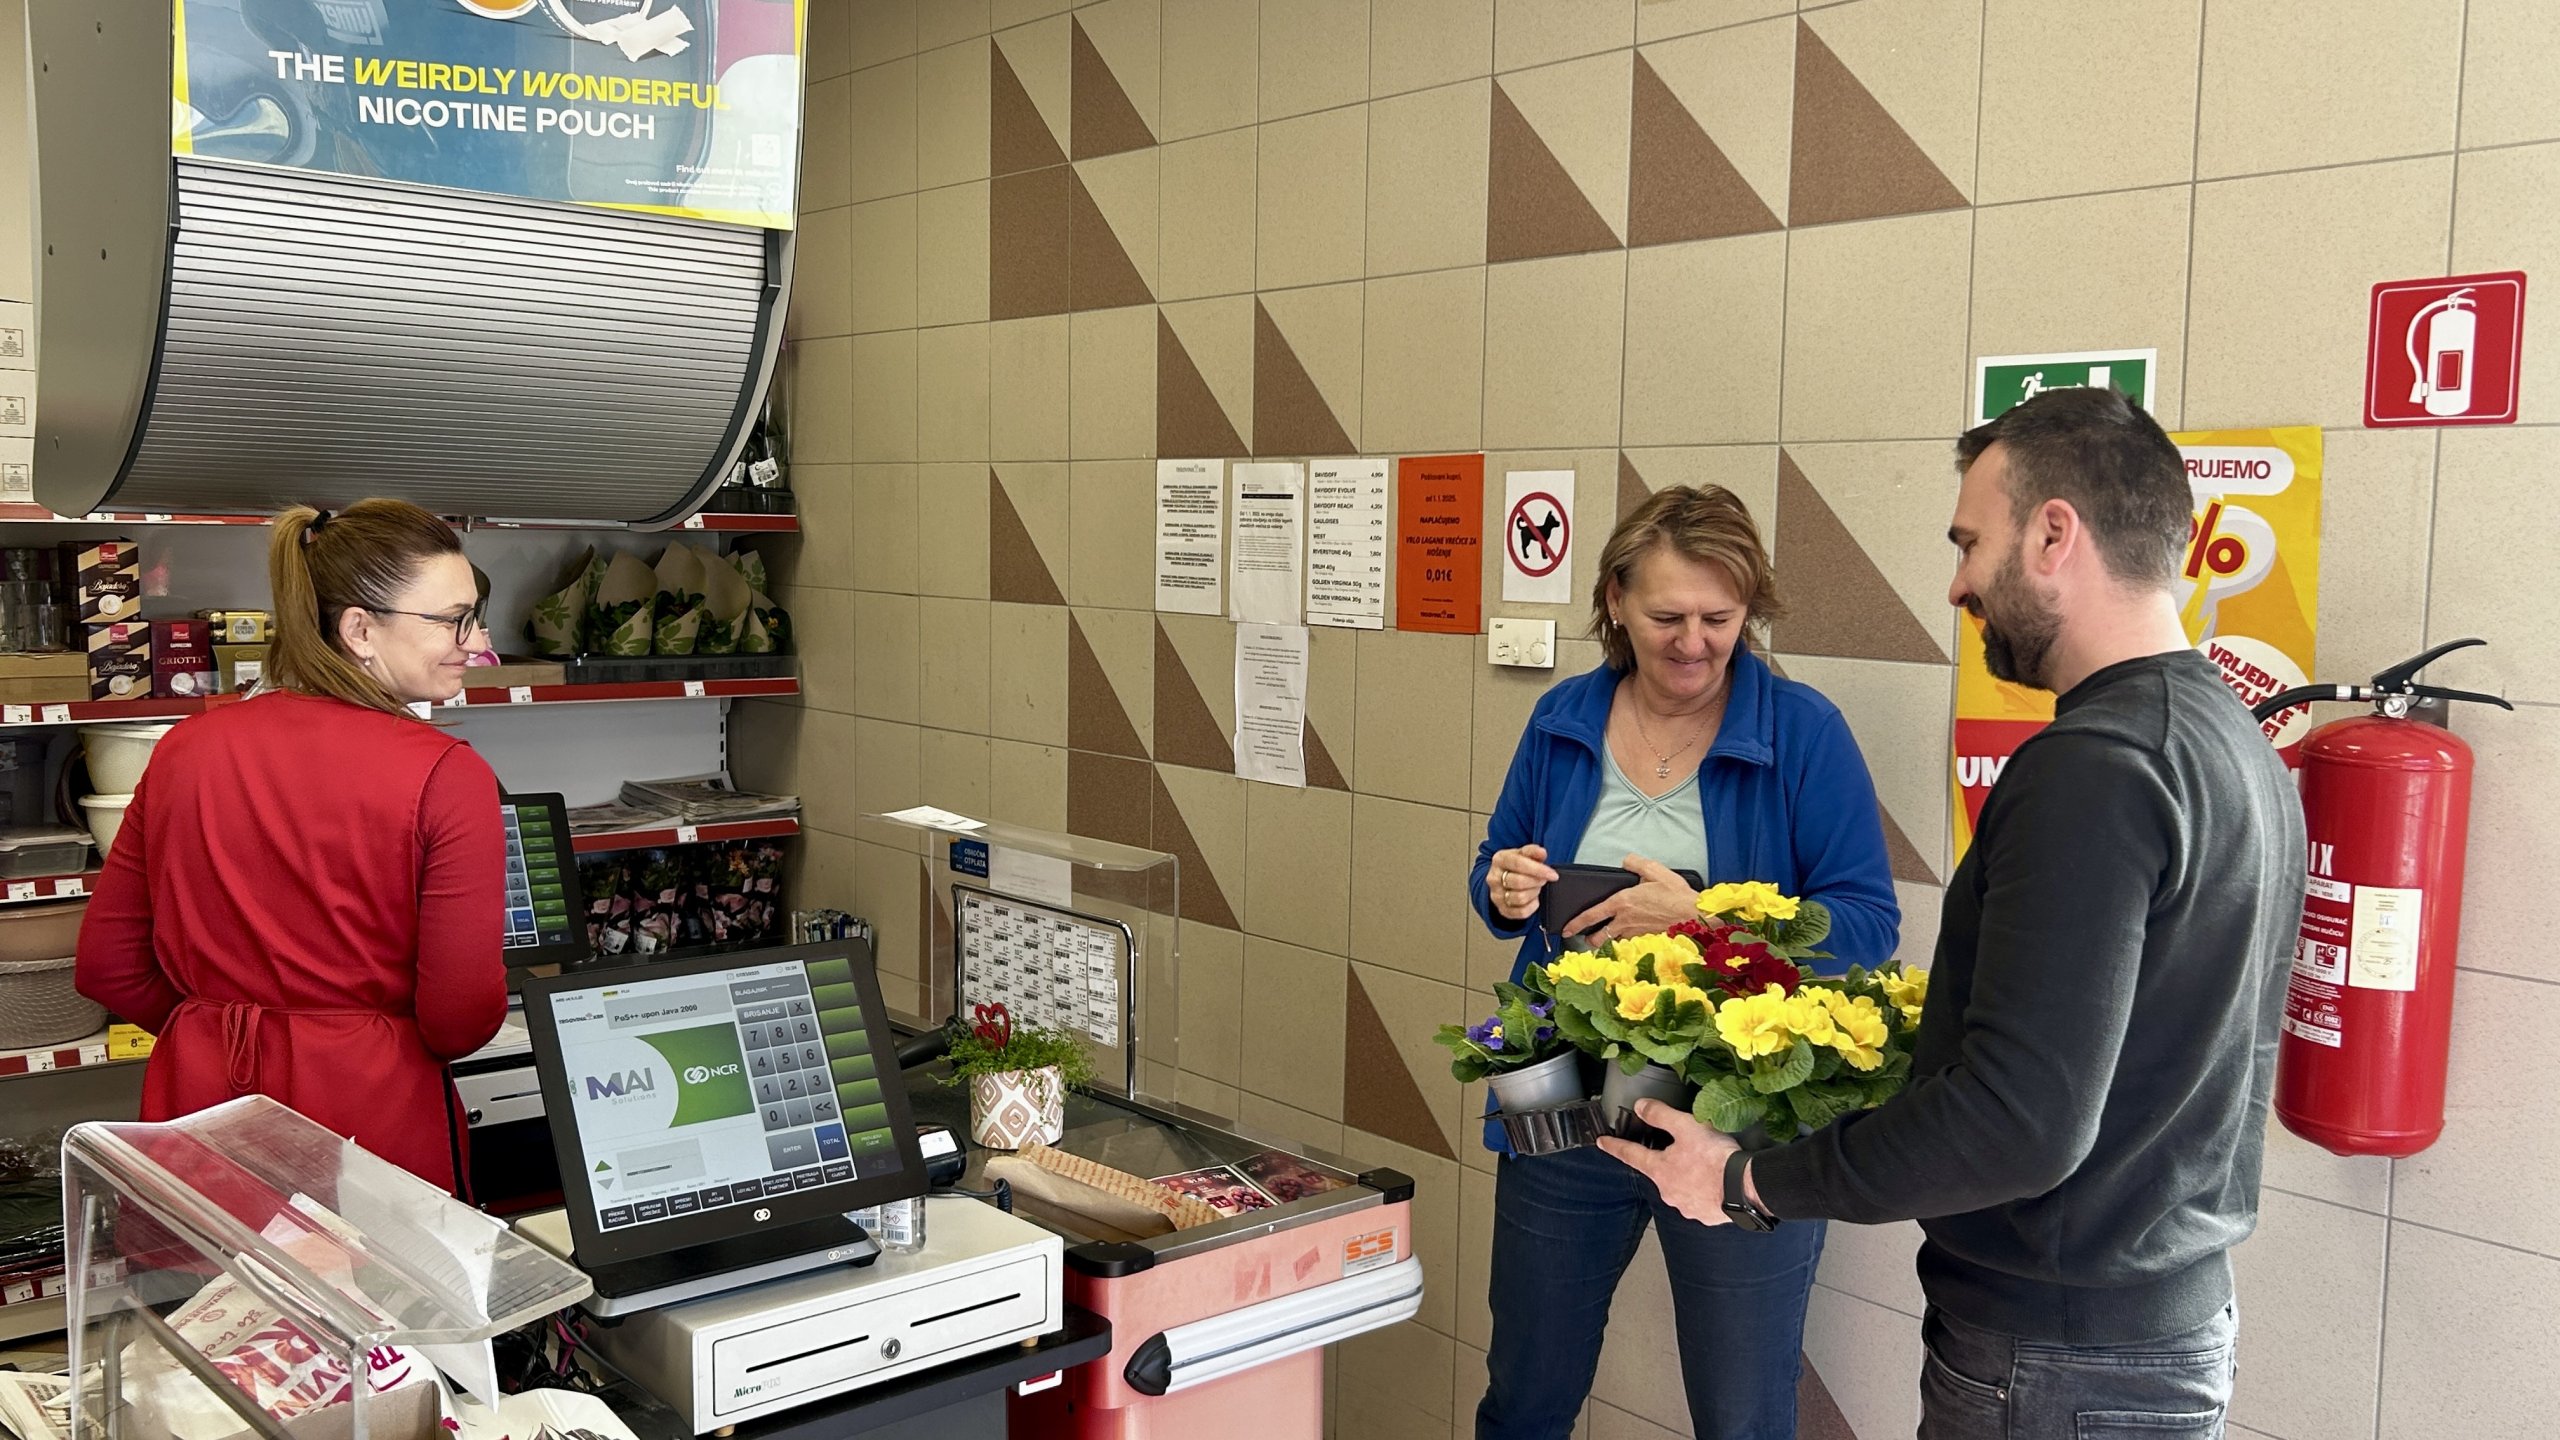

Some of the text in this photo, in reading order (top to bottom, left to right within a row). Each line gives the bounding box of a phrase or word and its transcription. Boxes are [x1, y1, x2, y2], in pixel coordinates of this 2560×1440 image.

[268, 50, 731, 110] THE WEIRDLY WONDERFUL
[358, 95, 655, 140] NICOTINE POUCH
[676, 164, 694, 174] Find
[696, 166, 711, 174] out
[2185, 459, 2271, 480] RUJEMO
[1420, 516, 1460, 526] NAPLAĆUJEMO
[1406, 536, 1421, 544] VRLO
[1421, 536, 1444, 545] LAGANE
[1469, 537, 1477, 545] ZA
[1426, 548, 1451, 558] NOŠENJE
[1426, 569, 1453, 582] 0,01€
[159, 656, 204, 665] GRIOTTE
[2208, 642, 2278, 693] VRIJEDI
[1956, 756, 2011, 788] UM
[964, 856, 986, 868] OTPLATA
[2310, 841, 2334, 877] IX
[2309, 879, 2333, 889] APARAT
[2328, 947, 2335, 955] C
[743, 1006, 780, 1019] BRISANJE
[794, 1002, 803, 1012] X
[614, 1004, 697, 1023] PoS++ upon Java 2000
[775, 1027, 784, 1038] 8
[800, 1023, 808, 1034] 9
[750, 1031, 758, 1042] 7
[782, 1053, 790, 1064] 5
[806, 1049, 814, 1060] 6
[758, 1057, 766, 1068] 4
[710, 1064, 739, 1077] NCR
[586, 1067, 655, 1101] MAI
[788, 1079, 797, 1091] 2
[813, 1075, 821, 1086] 3
[764, 1084, 770, 1095] 1
[612, 1093, 656, 1105] Solutions
[770, 1110, 778, 1121] 0
[823, 1137, 840, 1145] TOTAL
[783, 1145, 802, 1153] ENTER
